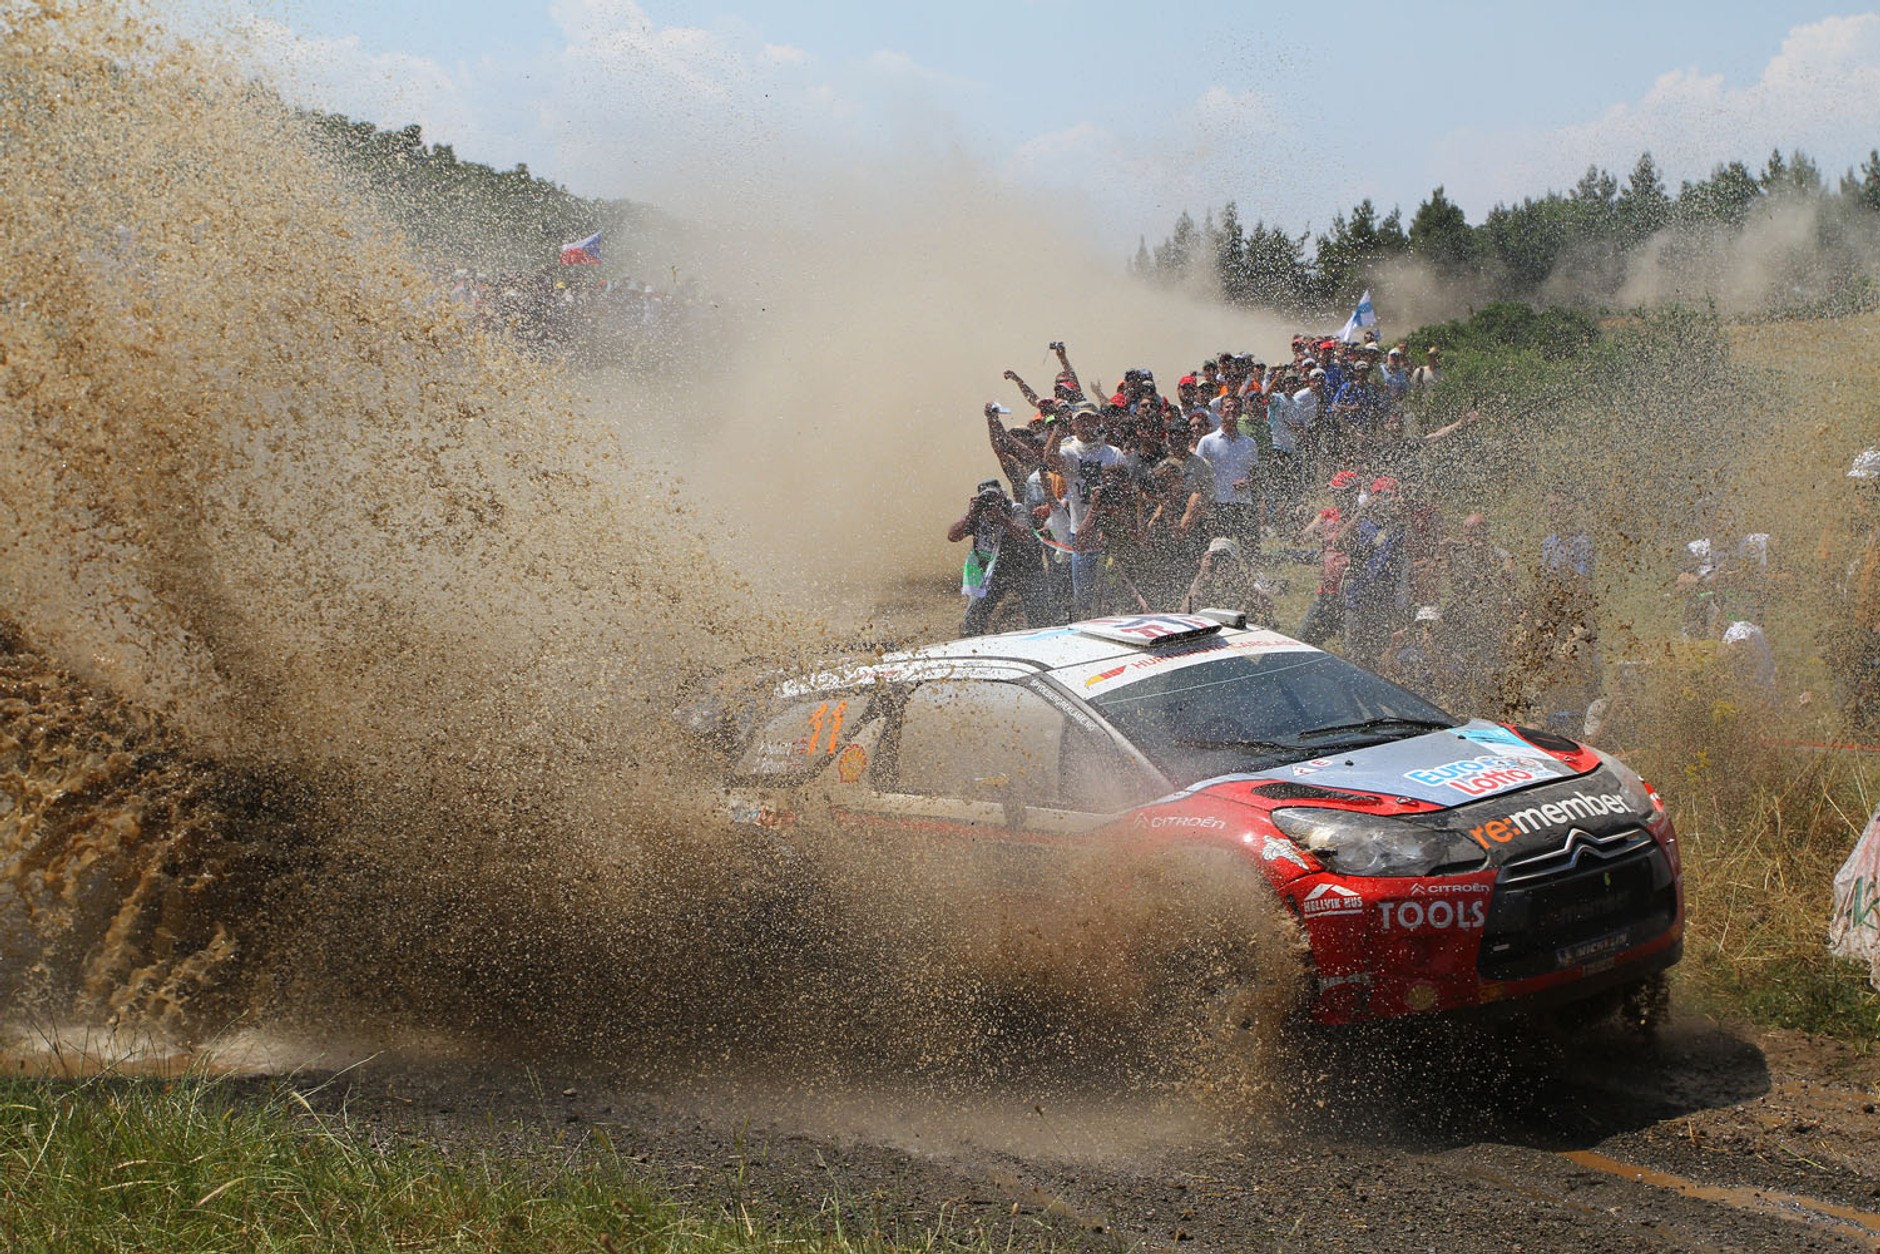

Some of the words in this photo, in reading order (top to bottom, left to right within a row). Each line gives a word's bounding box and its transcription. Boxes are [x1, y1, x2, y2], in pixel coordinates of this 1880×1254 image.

[808, 700, 848, 755] 11
[1449, 769, 1532, 795] Lotto
[1471, 791, 1633, 849] re:member
[1378, 901, 1485, 929] TOOLS
